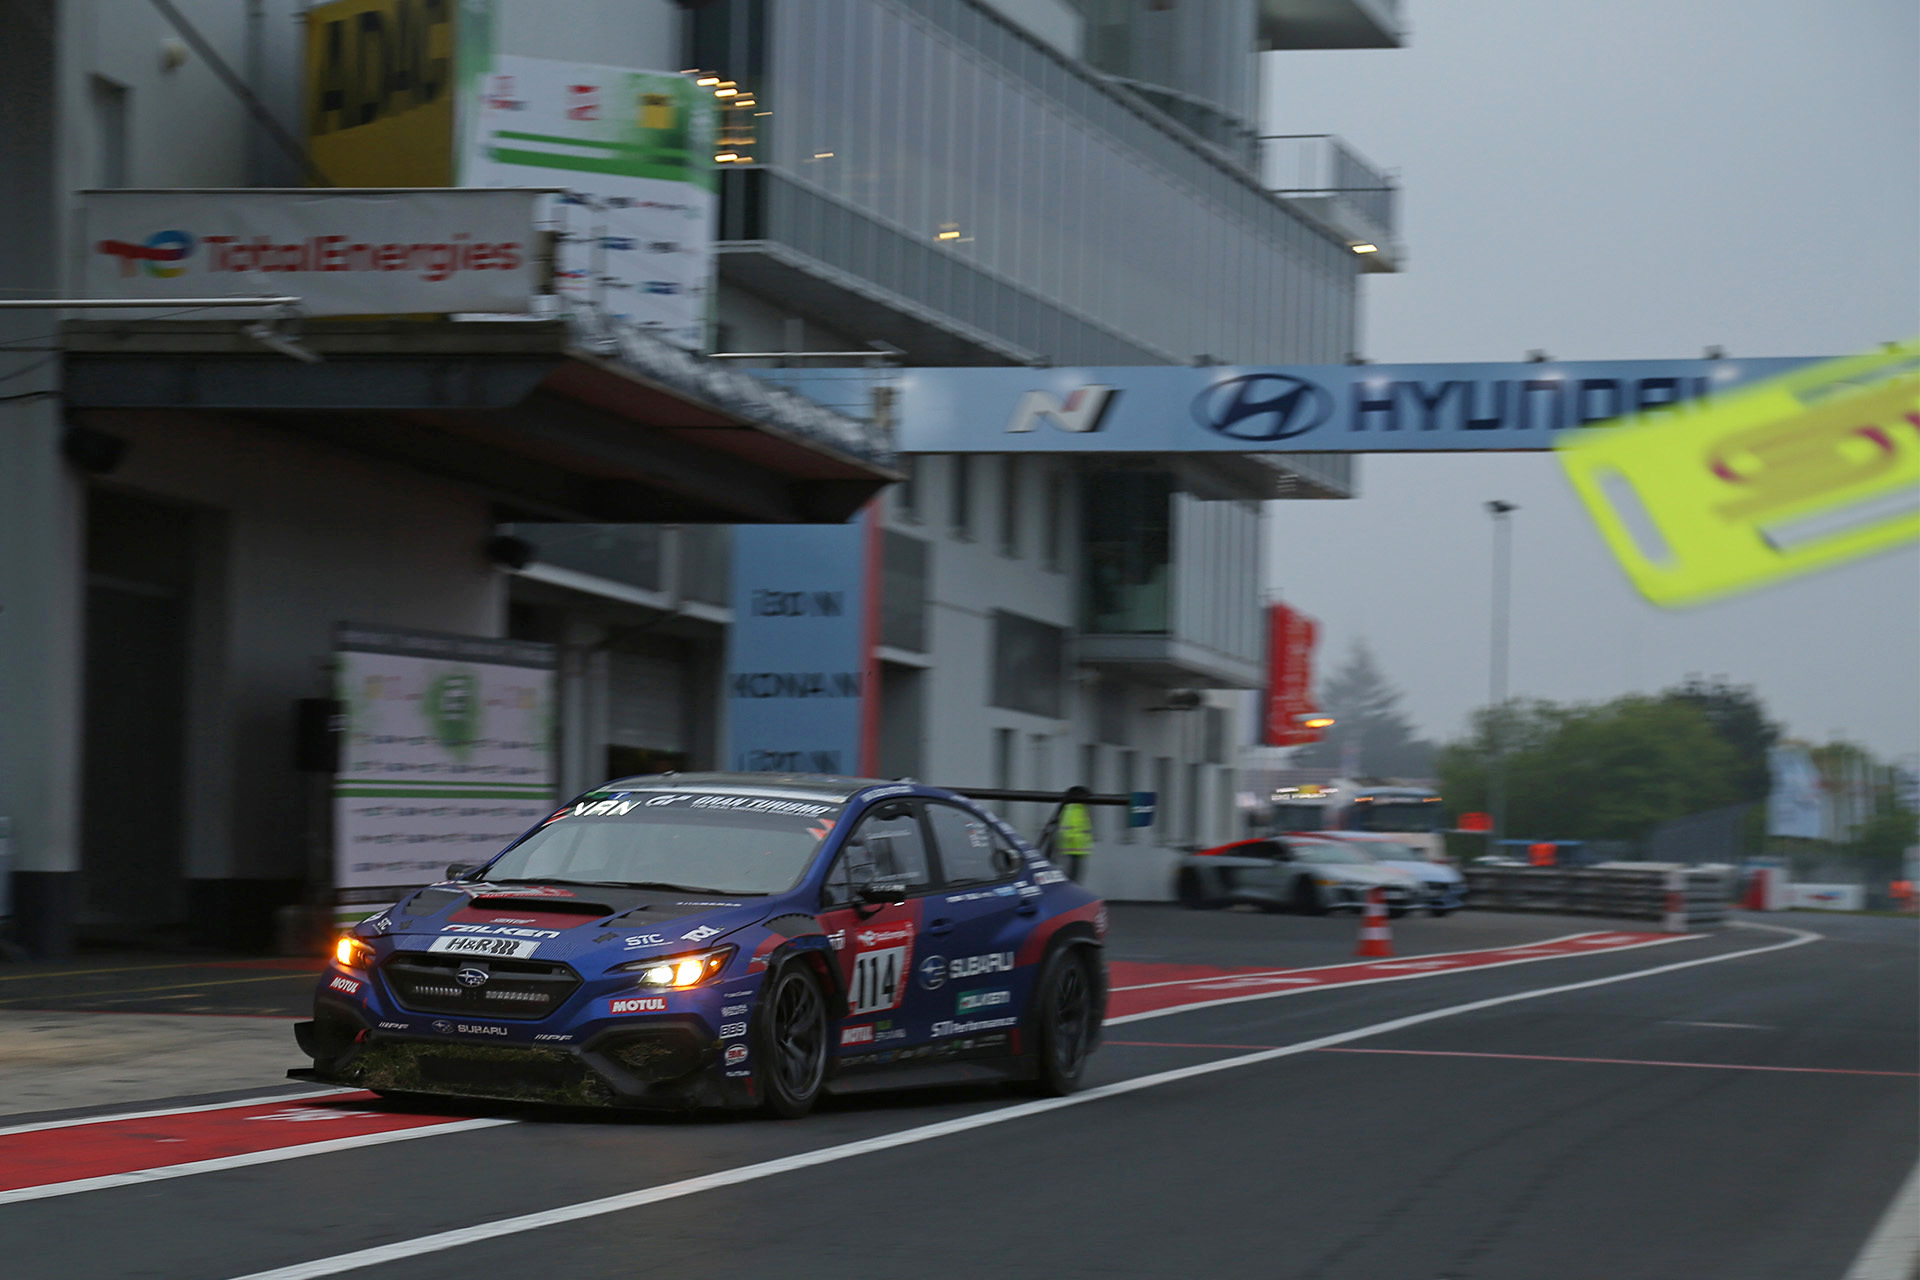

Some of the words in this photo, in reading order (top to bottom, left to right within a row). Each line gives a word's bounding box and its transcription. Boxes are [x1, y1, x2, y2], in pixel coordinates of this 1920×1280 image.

[313, 0, 450, 134] ADAC
[201, 235, 523, 281] TotalEnergies
[440, 924, 560, 939] FALKEN
[949, 952, 1014, 979] SUBARU
[331, 977, 360, 993] MOTUL
[856, 953, 896, 1009] 114
[612, 999, 665, 1012] MOTUL
[457, 1024, 508, 1036] SUBARU
